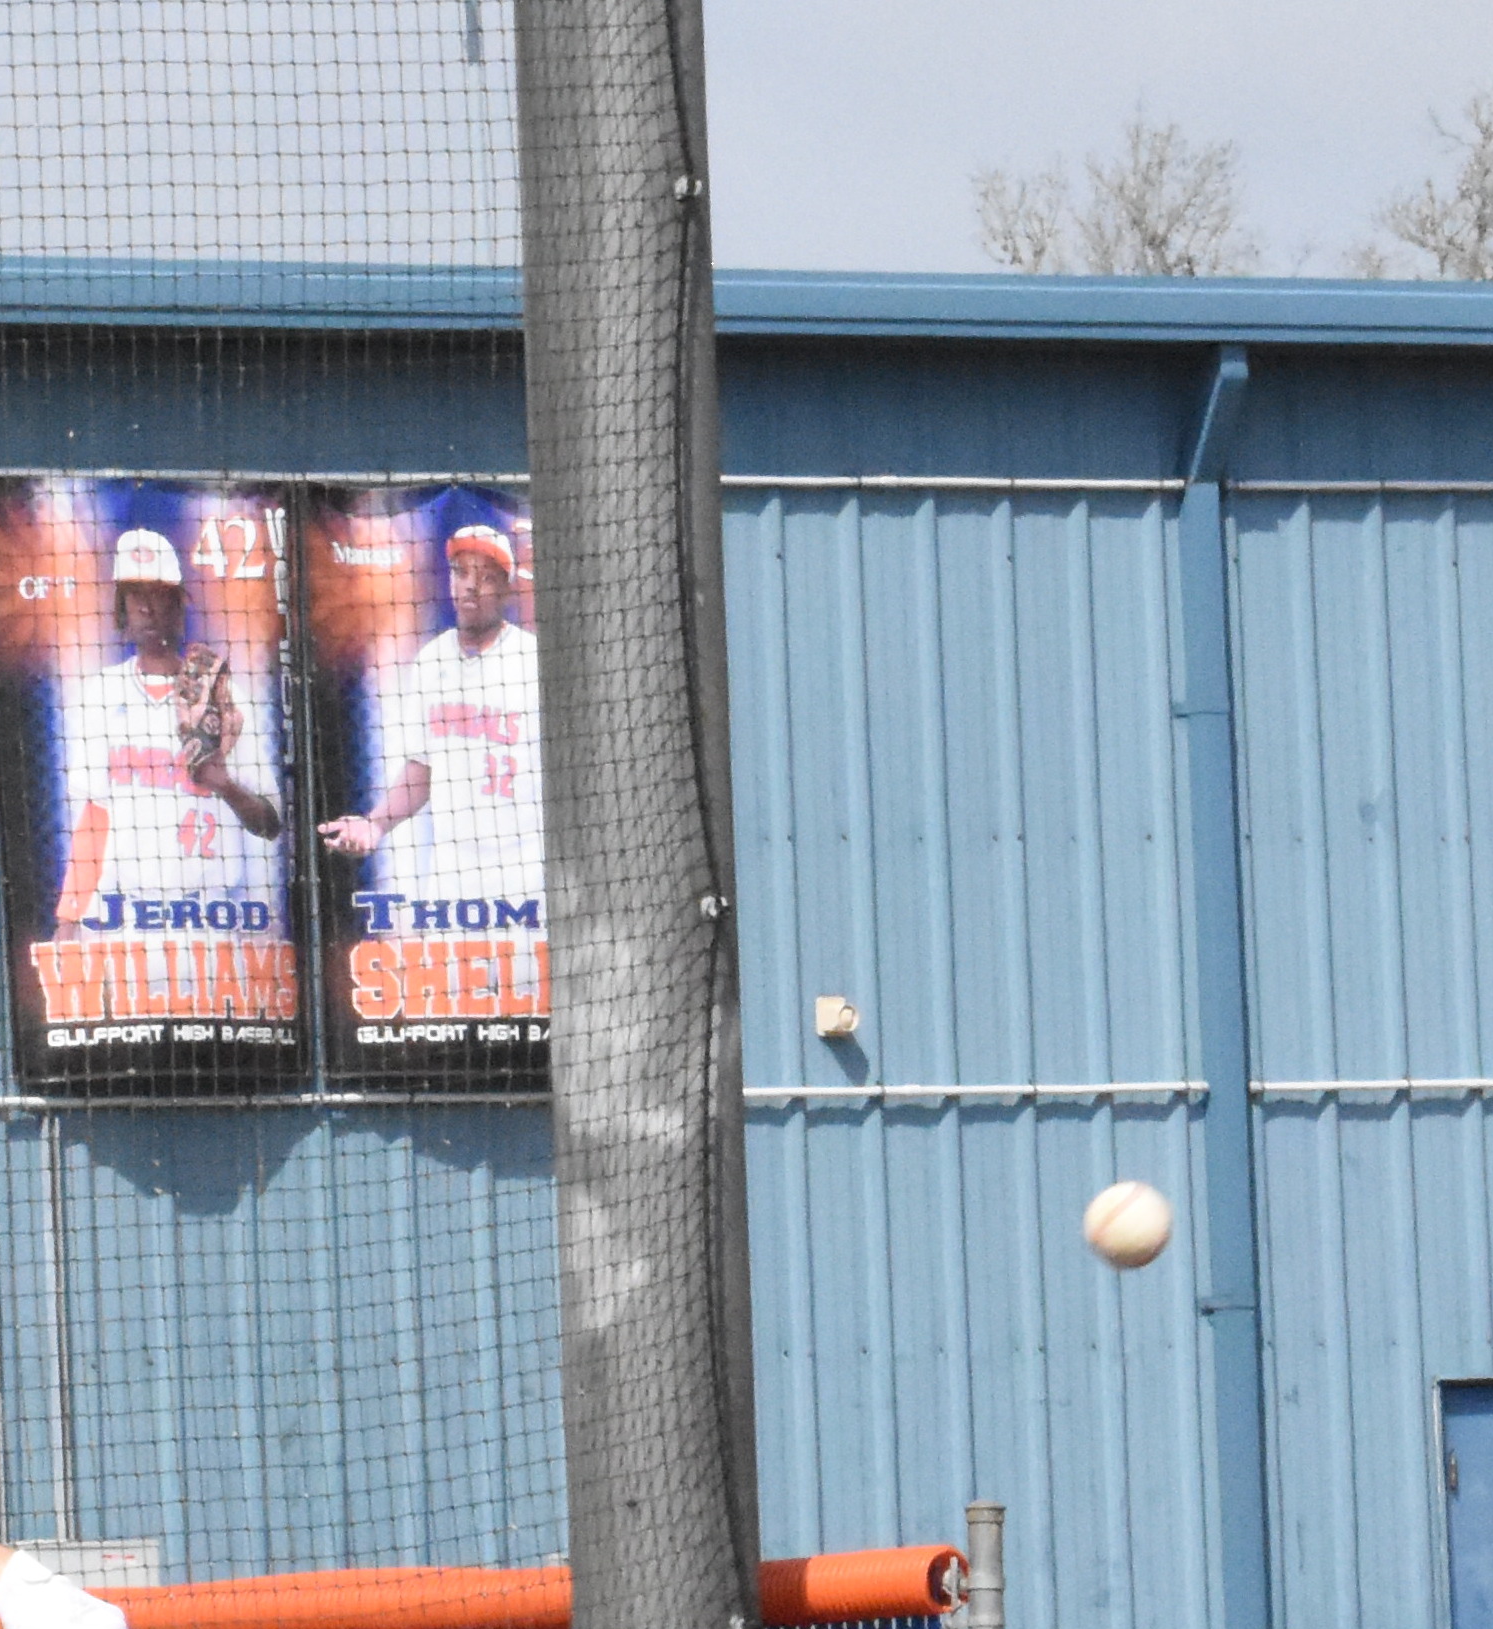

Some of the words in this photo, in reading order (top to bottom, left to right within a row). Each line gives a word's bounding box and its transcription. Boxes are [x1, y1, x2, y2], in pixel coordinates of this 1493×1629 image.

[191, 515, 266, 580] 42
[176, 808, 216, 860] 42
[81, 893, 270, 933] JEROD
[29, 940, 298, 1024] WILLIAMS
